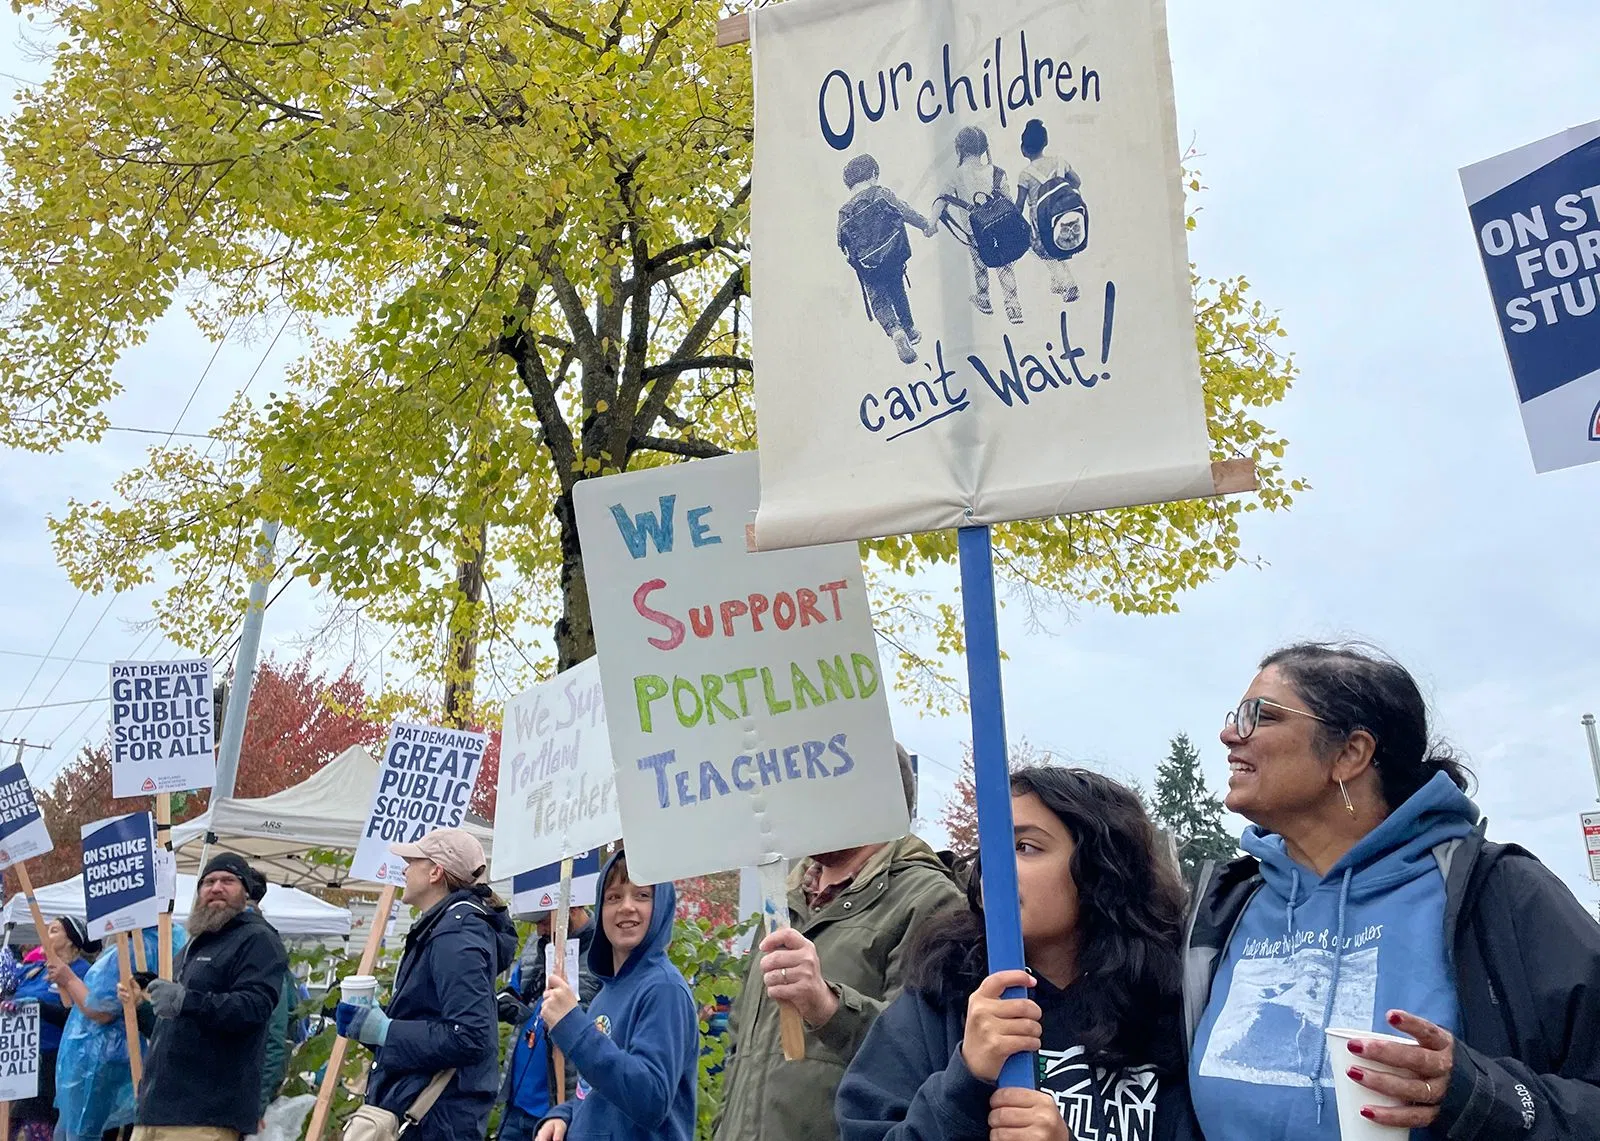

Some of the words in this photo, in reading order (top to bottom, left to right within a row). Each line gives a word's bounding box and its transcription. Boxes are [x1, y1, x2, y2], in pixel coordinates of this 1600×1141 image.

[818, 61, 913, 150] Our
[916, 30, 1101, 128] children
[1481, 205, 1549, 257] ON
[1555, 184, 1600, 231] ST
[1515, 229, 1600, 289] FOR
[859, 340, 969, 432] can't
[967, 281, 1116, 407] Wait!
[633, 579, 848, 651] SUPPORT
[112, 666, 137, 677] PAT
[140, 662, 207, 676] DEMANDS
[113, 674, 208, 702] GREAT
[633, 652, 879, 733] PORTLAND
[113, 697, 210, 725] PUBLIC
[514, 695, 550, 744] We
[114, 719, 211, 742] SCHOOLS
[395, 726, 420, 742] PAT
[421, 730, 484, 752] DEMANDS
[115, 741, 162, 763] FOR
[168, 736, 212, 758] ALL
[388, 741, 480, 780] GREAT
[511, 729, 581, 796] Portland
[636, 733, 855, 809] TEACHERS
[0, 778, 29, 799] RIKE
[379, 769, 470, 807] PUBLIC
[374, 796, 463, 828] SCHOOLS
[526, 772, 618, 840] Teacher
[261, 820, 282, 829] ARS
[366, 815, 408, 843] FOR
[83, 848, 98, 865] ON
[99, 837, 147, 861] STRIKE
[86, 863, 109, 882] FOR
[109, 855, 145, 876] SAFE
[89, 872, 145, 898] SCHOOLS
[1318, 928, 1329, 949] of
[1, 1015, 38, 1034] EAT
[0, 1032, 37, 1051] BLIC
[0, 1048, 37, 1063] OOLS
[6, 1060, 36, 1077] ALL
[1057, 1091, 1157, 1141] TLAN
